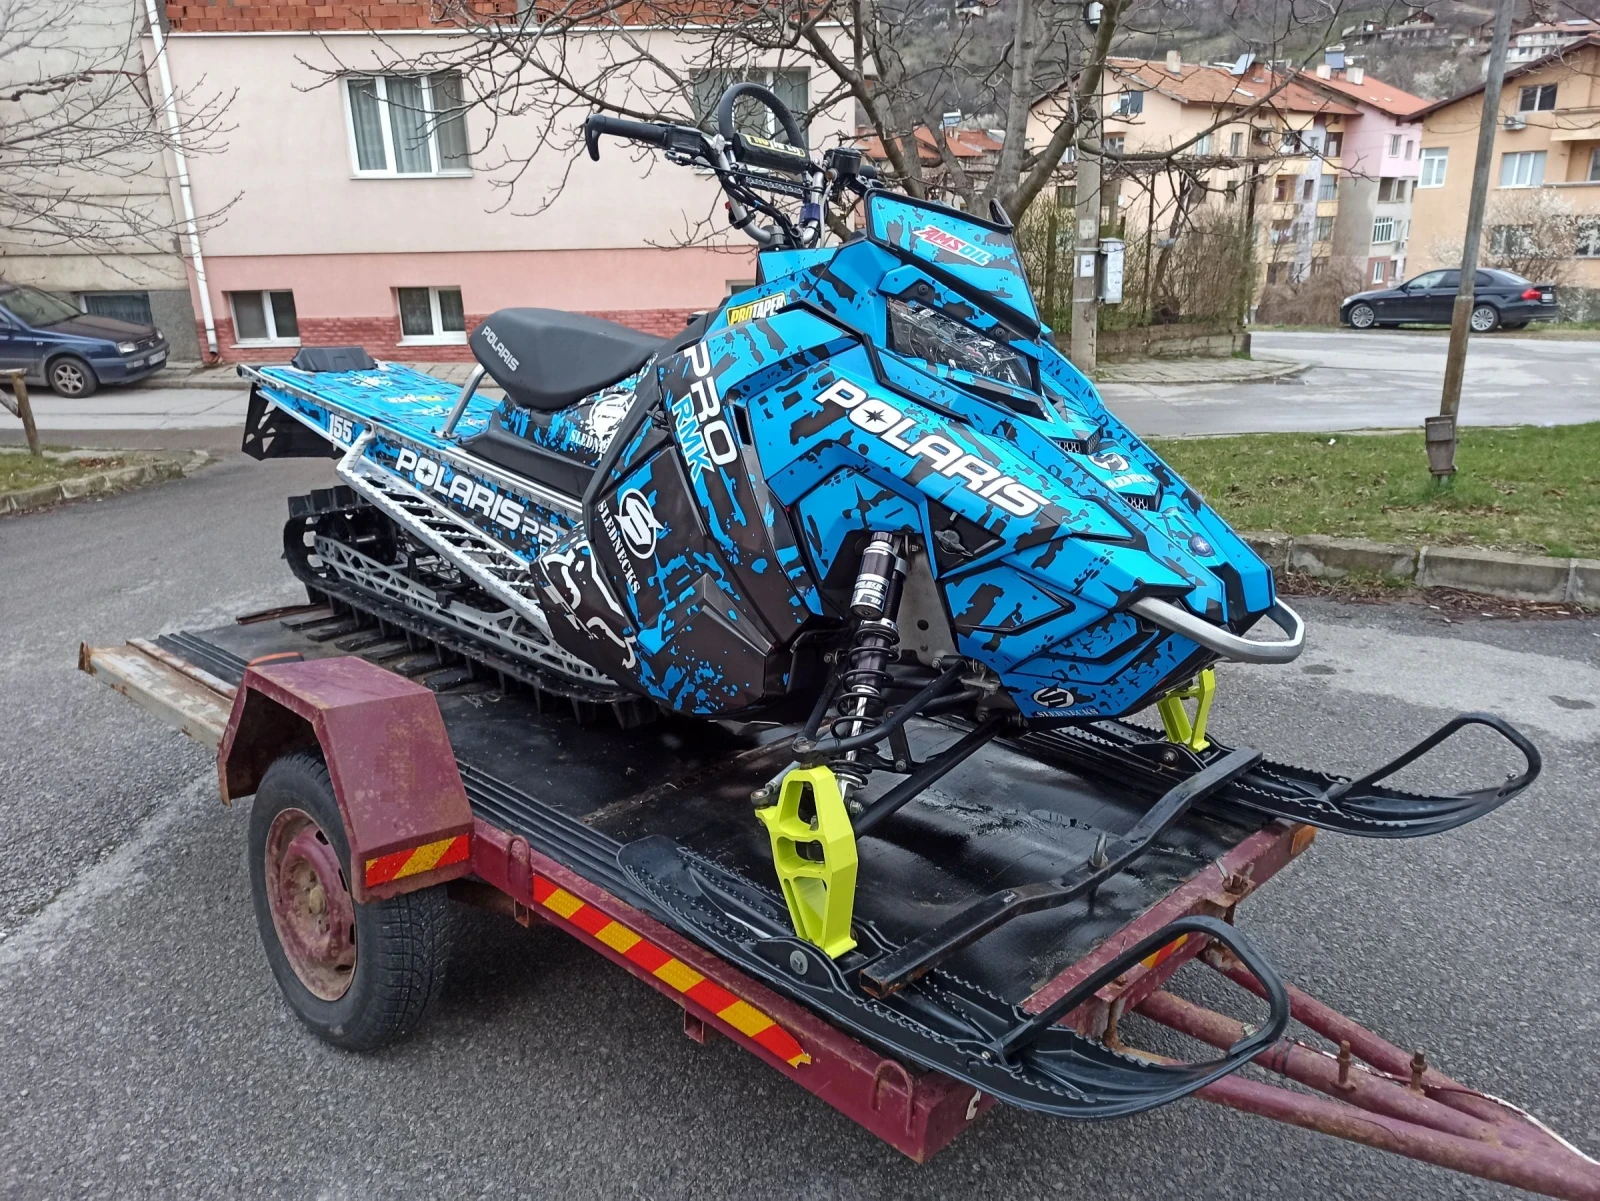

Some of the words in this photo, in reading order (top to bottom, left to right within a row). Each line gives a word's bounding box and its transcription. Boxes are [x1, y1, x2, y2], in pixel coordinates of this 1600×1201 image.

[917, 226, 991, 265] AMSOIL
[730, 295, 785, 325] PROTAPER
[481, 325, 520, 371] POLARIS
[329, 413, 353, 443] 155
[684, 341, 738, 465] PRO
[672, 392, 716, 485] RMK
[816, 378, 1051, 518] POLARIS
[395, 447, 524, 531] POLARIS
[597, 499, 641, 594] SLEDNECKS
[1036, 708, 1100, 718] SLEDNECKS
